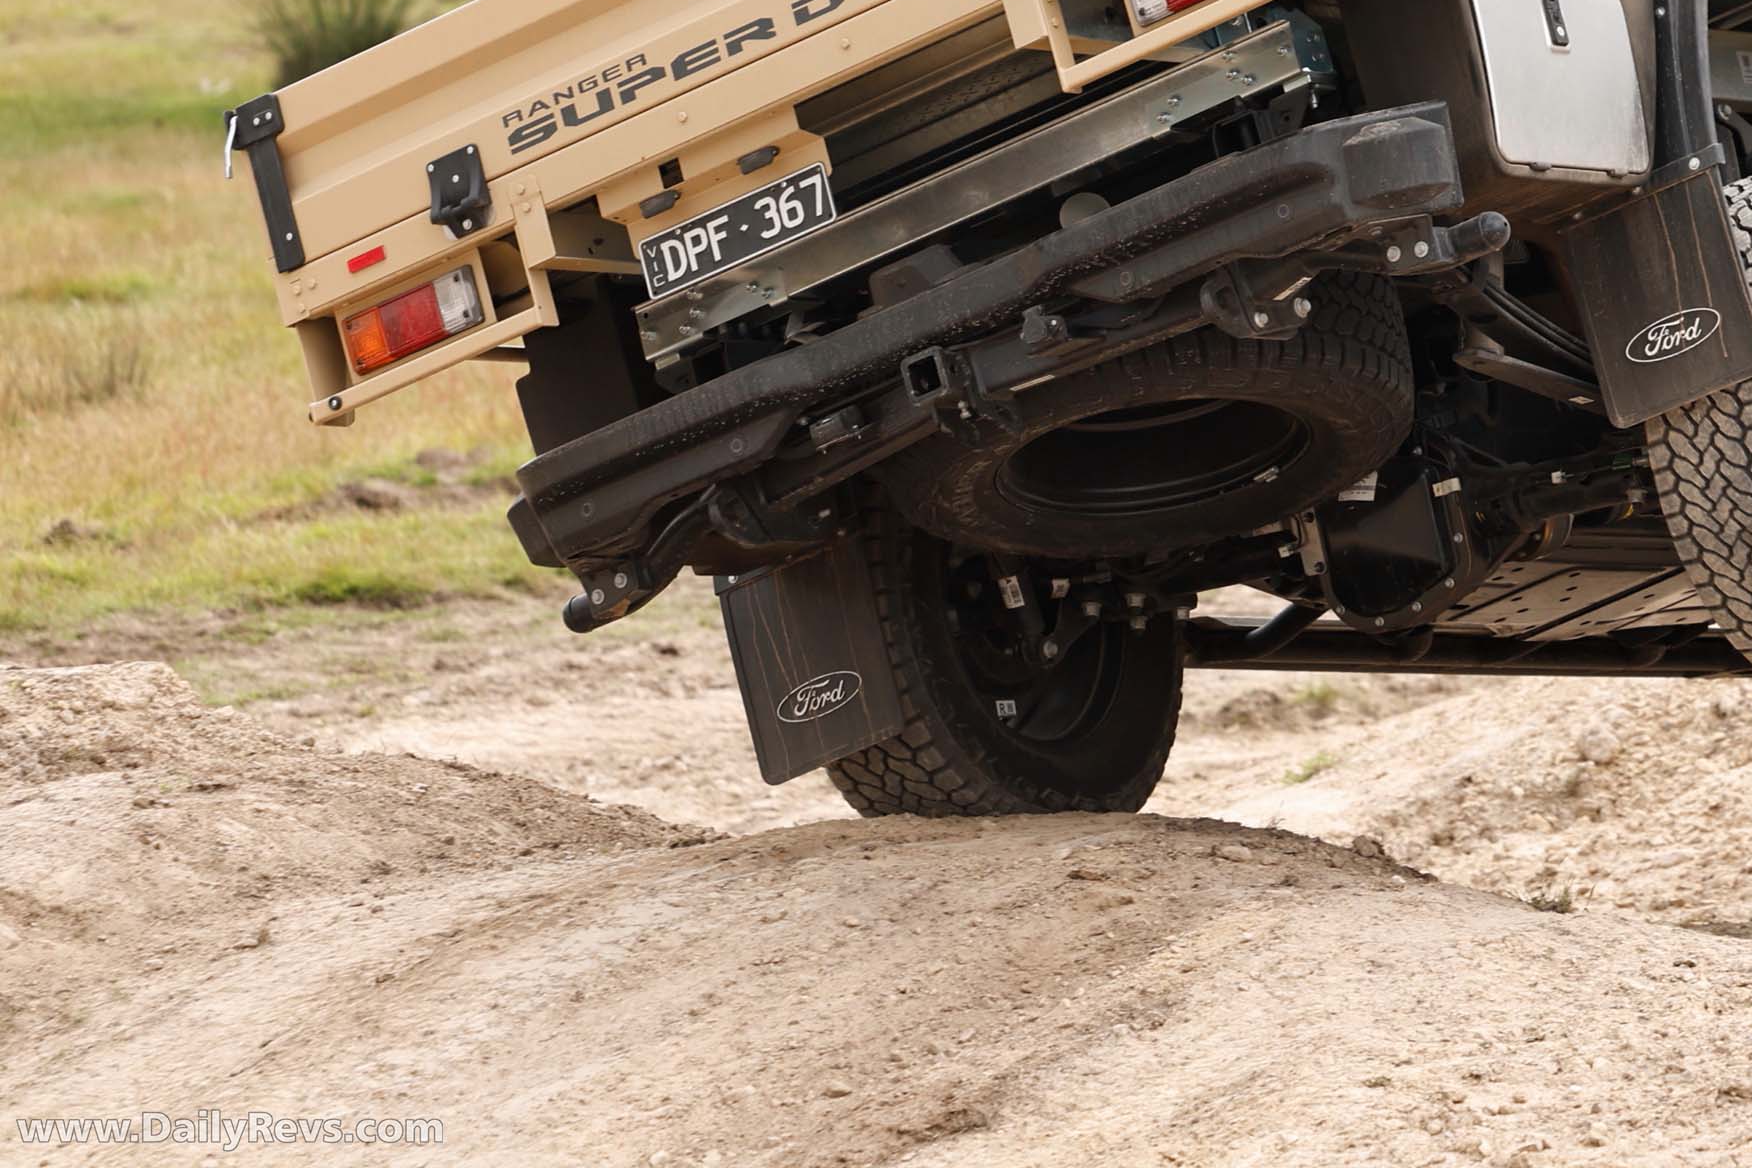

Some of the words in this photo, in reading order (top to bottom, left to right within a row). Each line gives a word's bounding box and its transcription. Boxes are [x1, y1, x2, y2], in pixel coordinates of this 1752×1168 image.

[502, 53, 648, 129] RANGER
[508, 17, 777, 155] SUPER
[660, 214, 730, 282] DPF
[753, 173, 824, 240] 367
[646, 245, 666, 288] VIC
[1644, 317, 1702, 356] Ford
[794, 679, 845, 716] Ford
